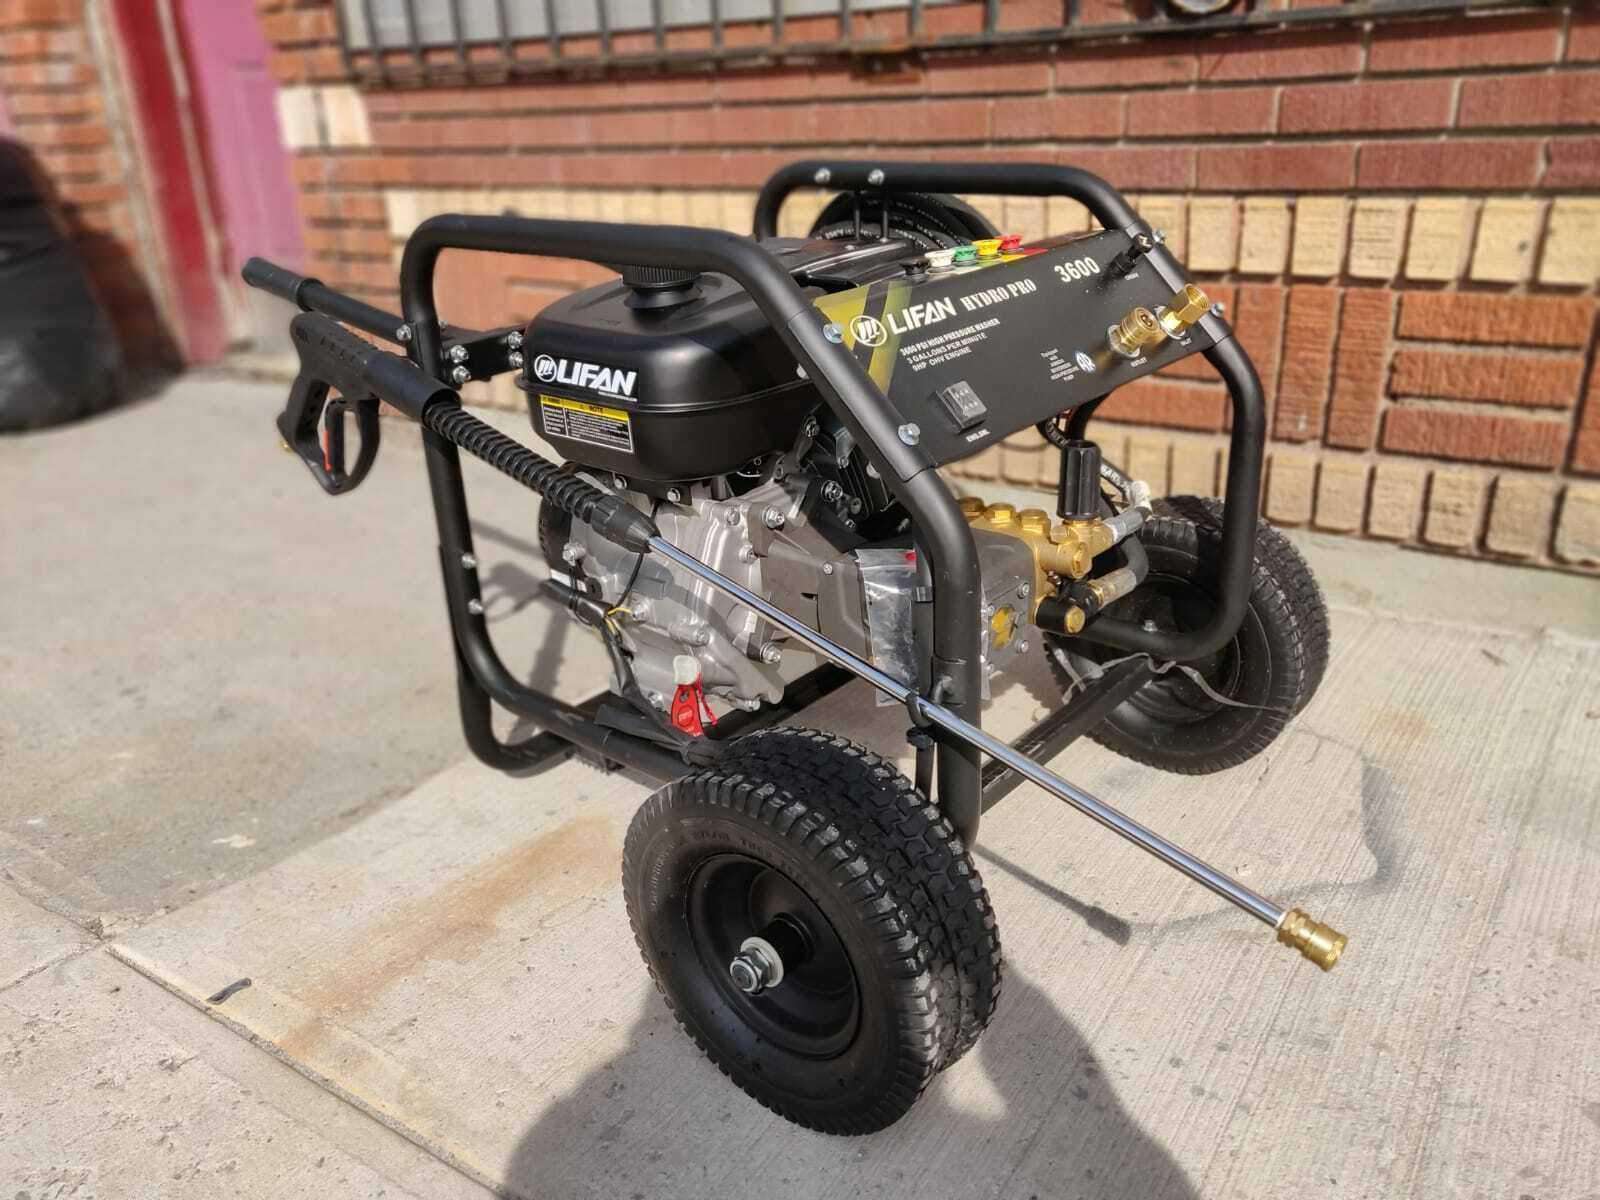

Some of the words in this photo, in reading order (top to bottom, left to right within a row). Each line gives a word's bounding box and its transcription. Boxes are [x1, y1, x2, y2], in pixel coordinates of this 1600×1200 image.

[887, 297, 957, 335] LIFAN
[960, 286, 1010, 312] HYDRO
[1008, 279, 1037, 299] PRO
[1054, 257, 1100, 283] 3600
[906, 357, 913, 365] 3
[912, 345, 947, 362] GALLONS
[945, 341, 961, 351] PER
[960, 332, 988, 345] MINUTE
[915, 341, 929, 351] PSI
[927, 336, 946, 347] HIGH
[943, 326, 976, 341] PRESSURE
[974, 318, 1000, 331] WASHER
[928, 355, 945, 366] OHV
[944, 346, 972, 360] ENGINE
[557, 359, 637, 396] LIFAN
